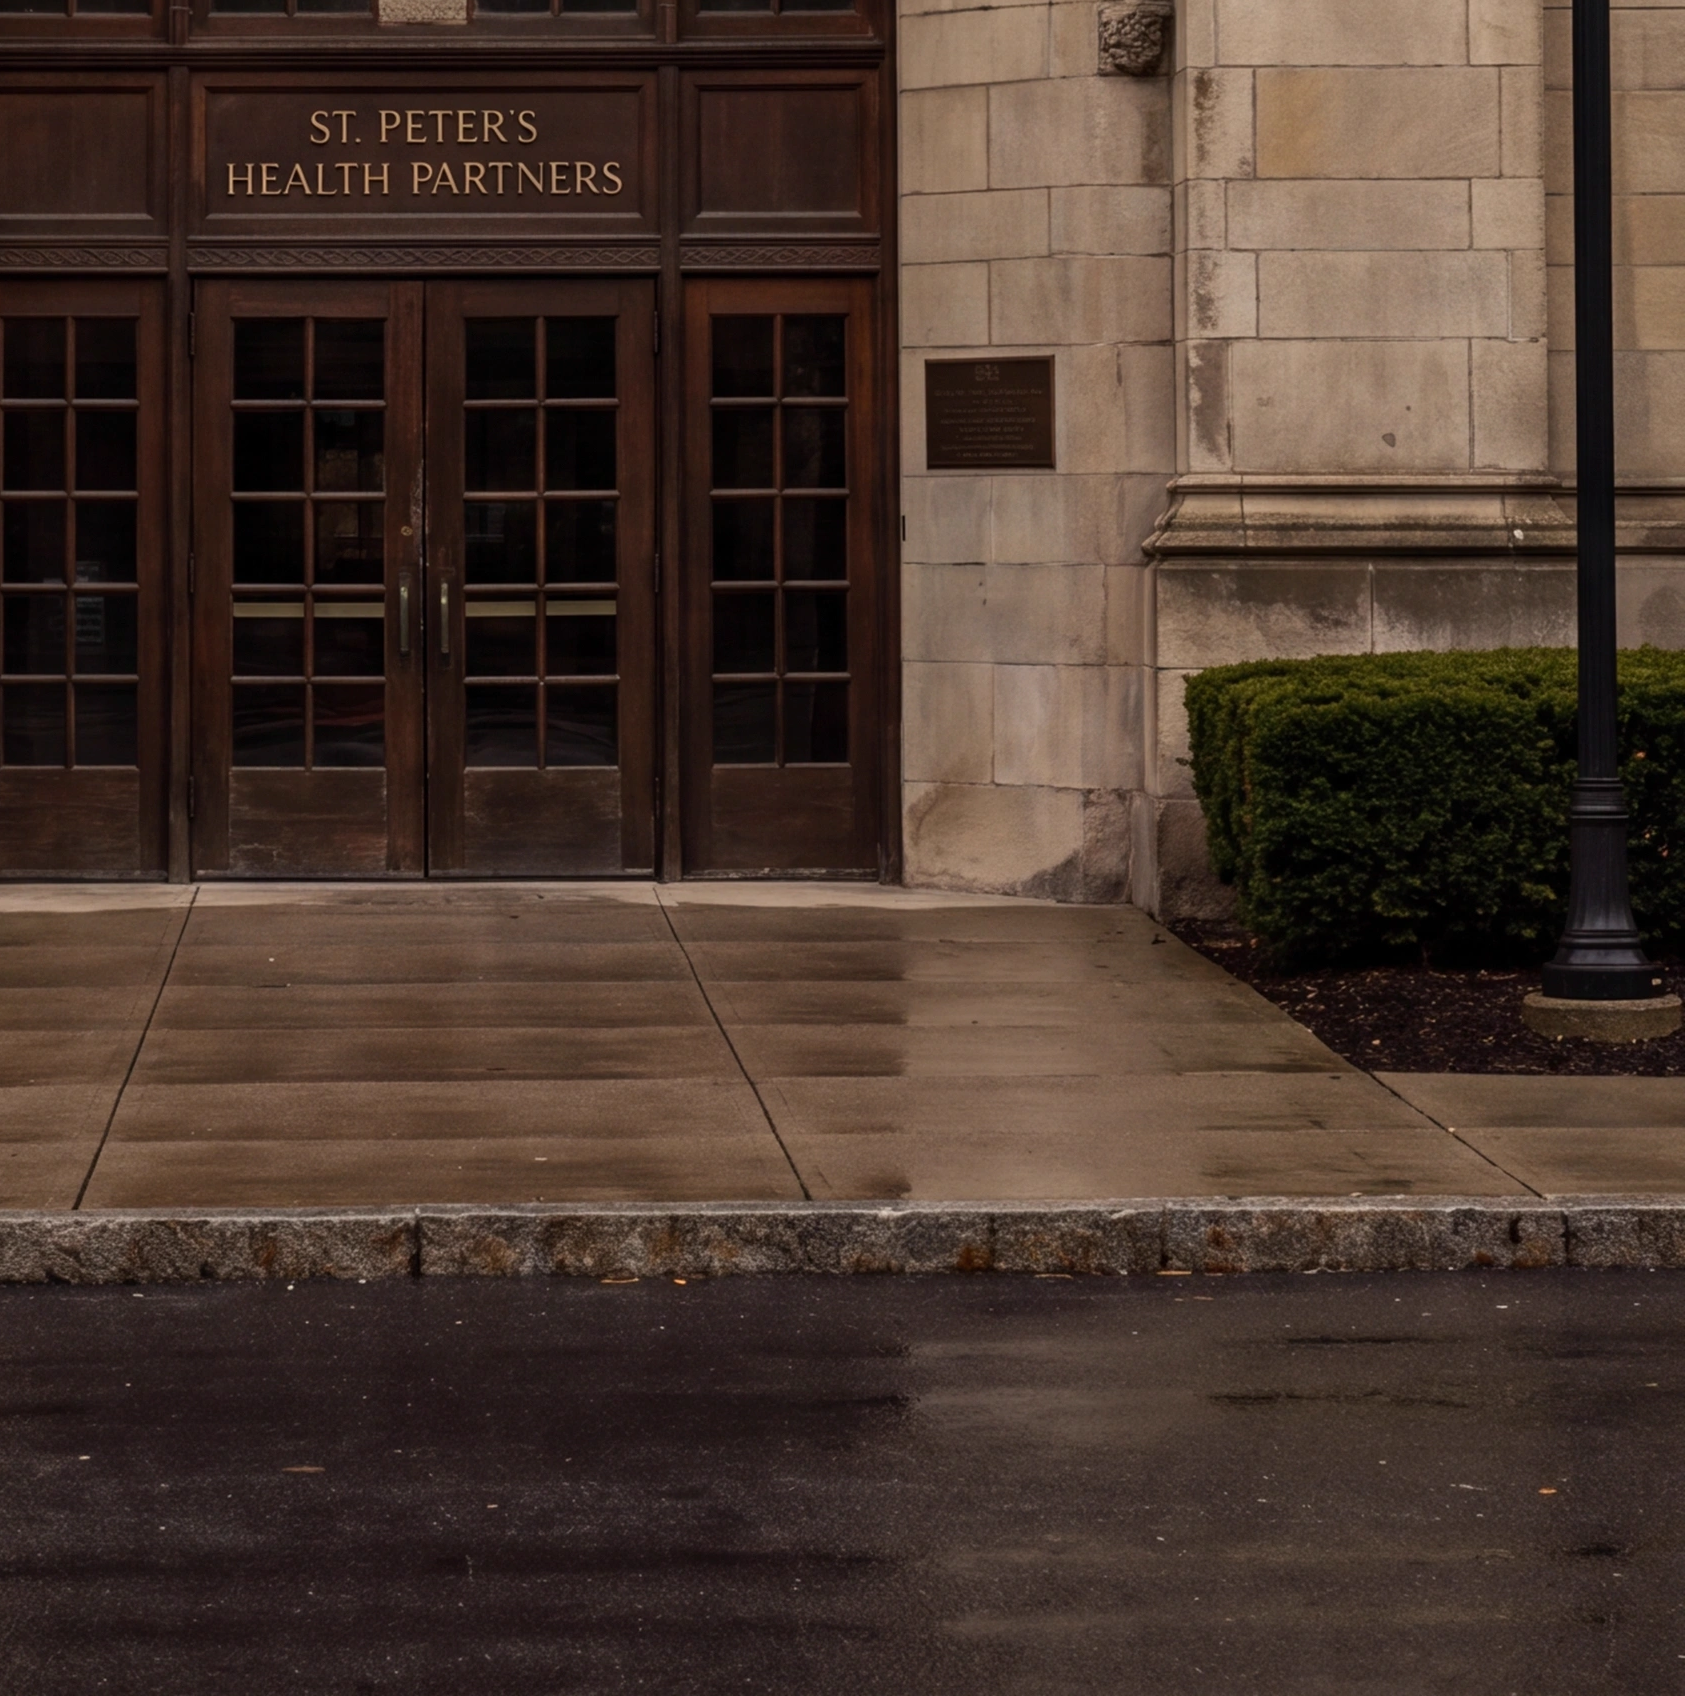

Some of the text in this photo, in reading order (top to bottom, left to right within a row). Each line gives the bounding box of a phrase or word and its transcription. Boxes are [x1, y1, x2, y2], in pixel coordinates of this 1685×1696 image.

[309, 109, 539, 145] ST. PETER'S
[226, 161, 623, 196] HEALTH PARTNERS
